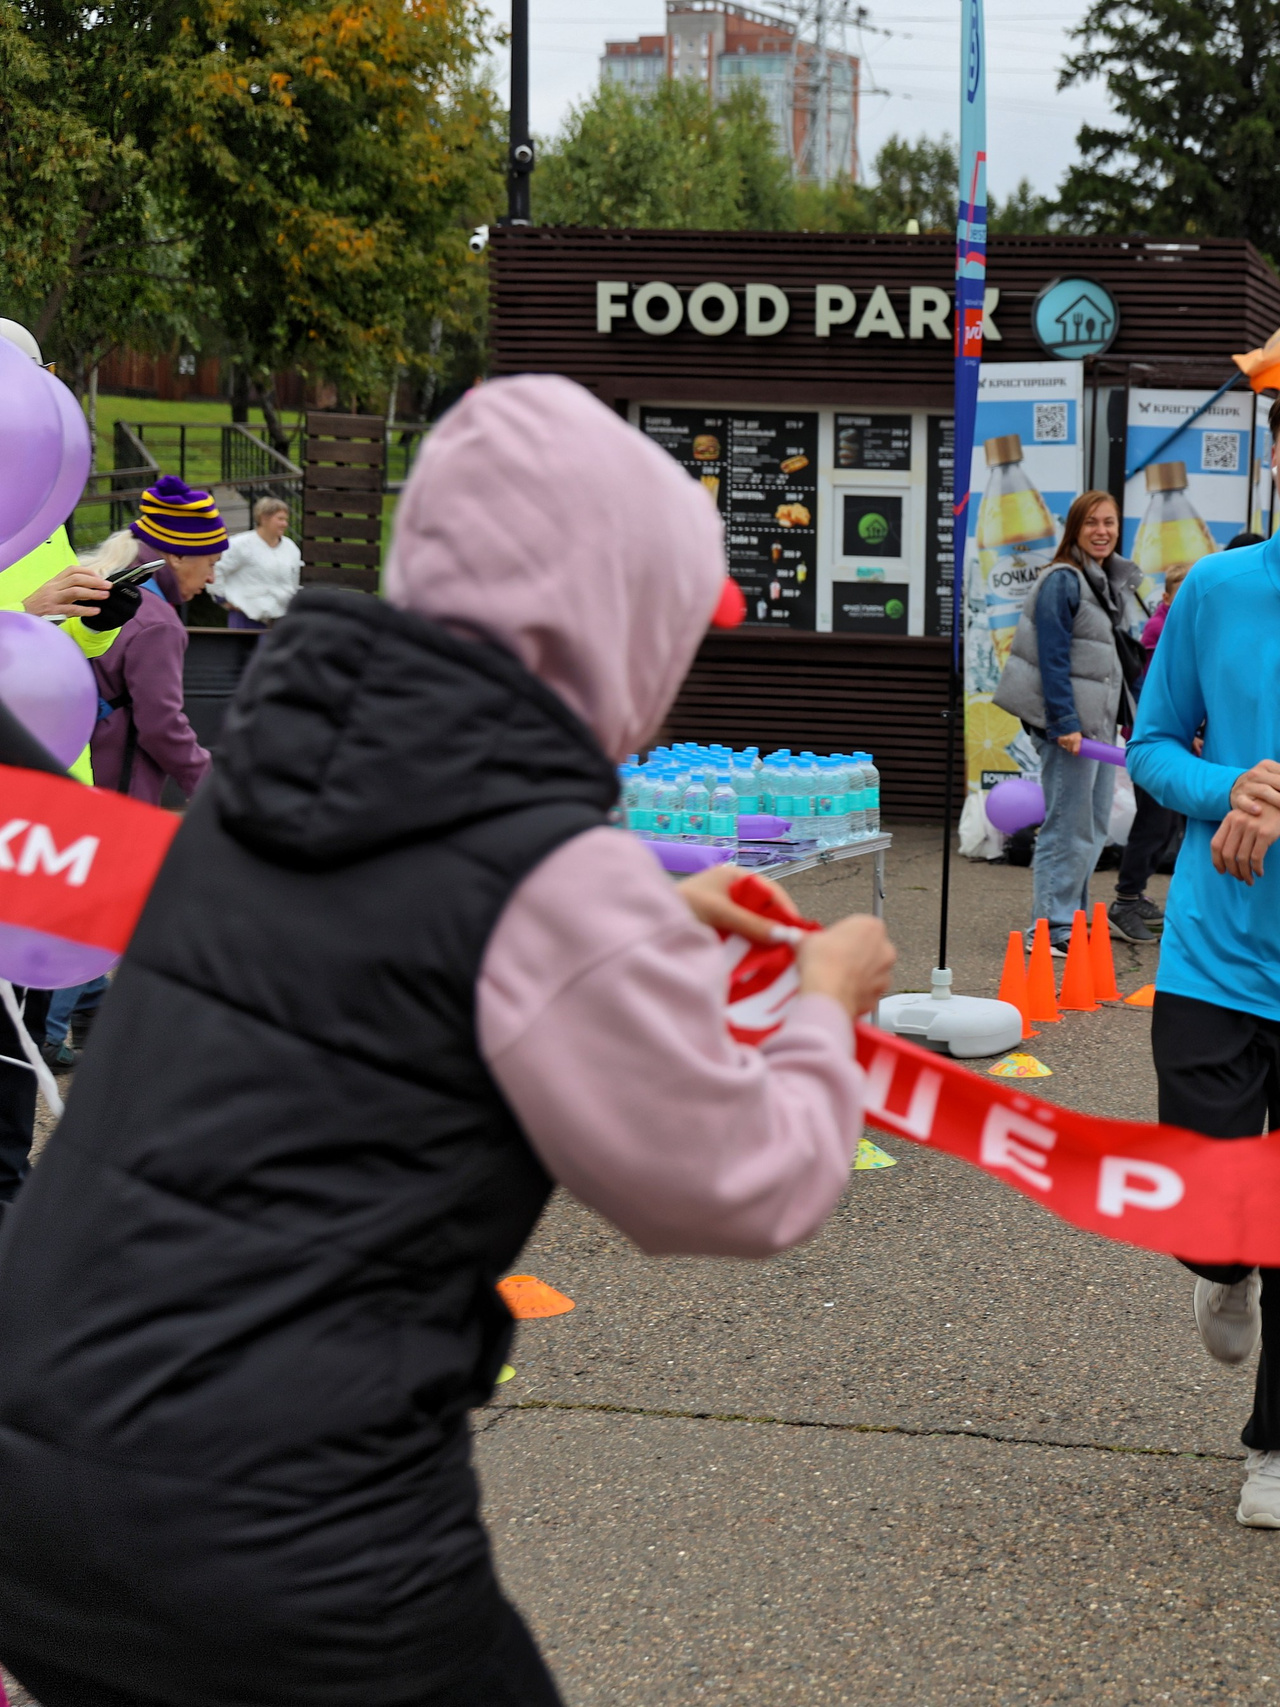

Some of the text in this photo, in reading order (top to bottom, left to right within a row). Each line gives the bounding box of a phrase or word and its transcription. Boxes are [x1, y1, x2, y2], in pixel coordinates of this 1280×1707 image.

[596, 281, 790, 337] FOOD
[815, 284, 1002, 341] PARK
[992, 566, 1041, 588] БОЧКАР
